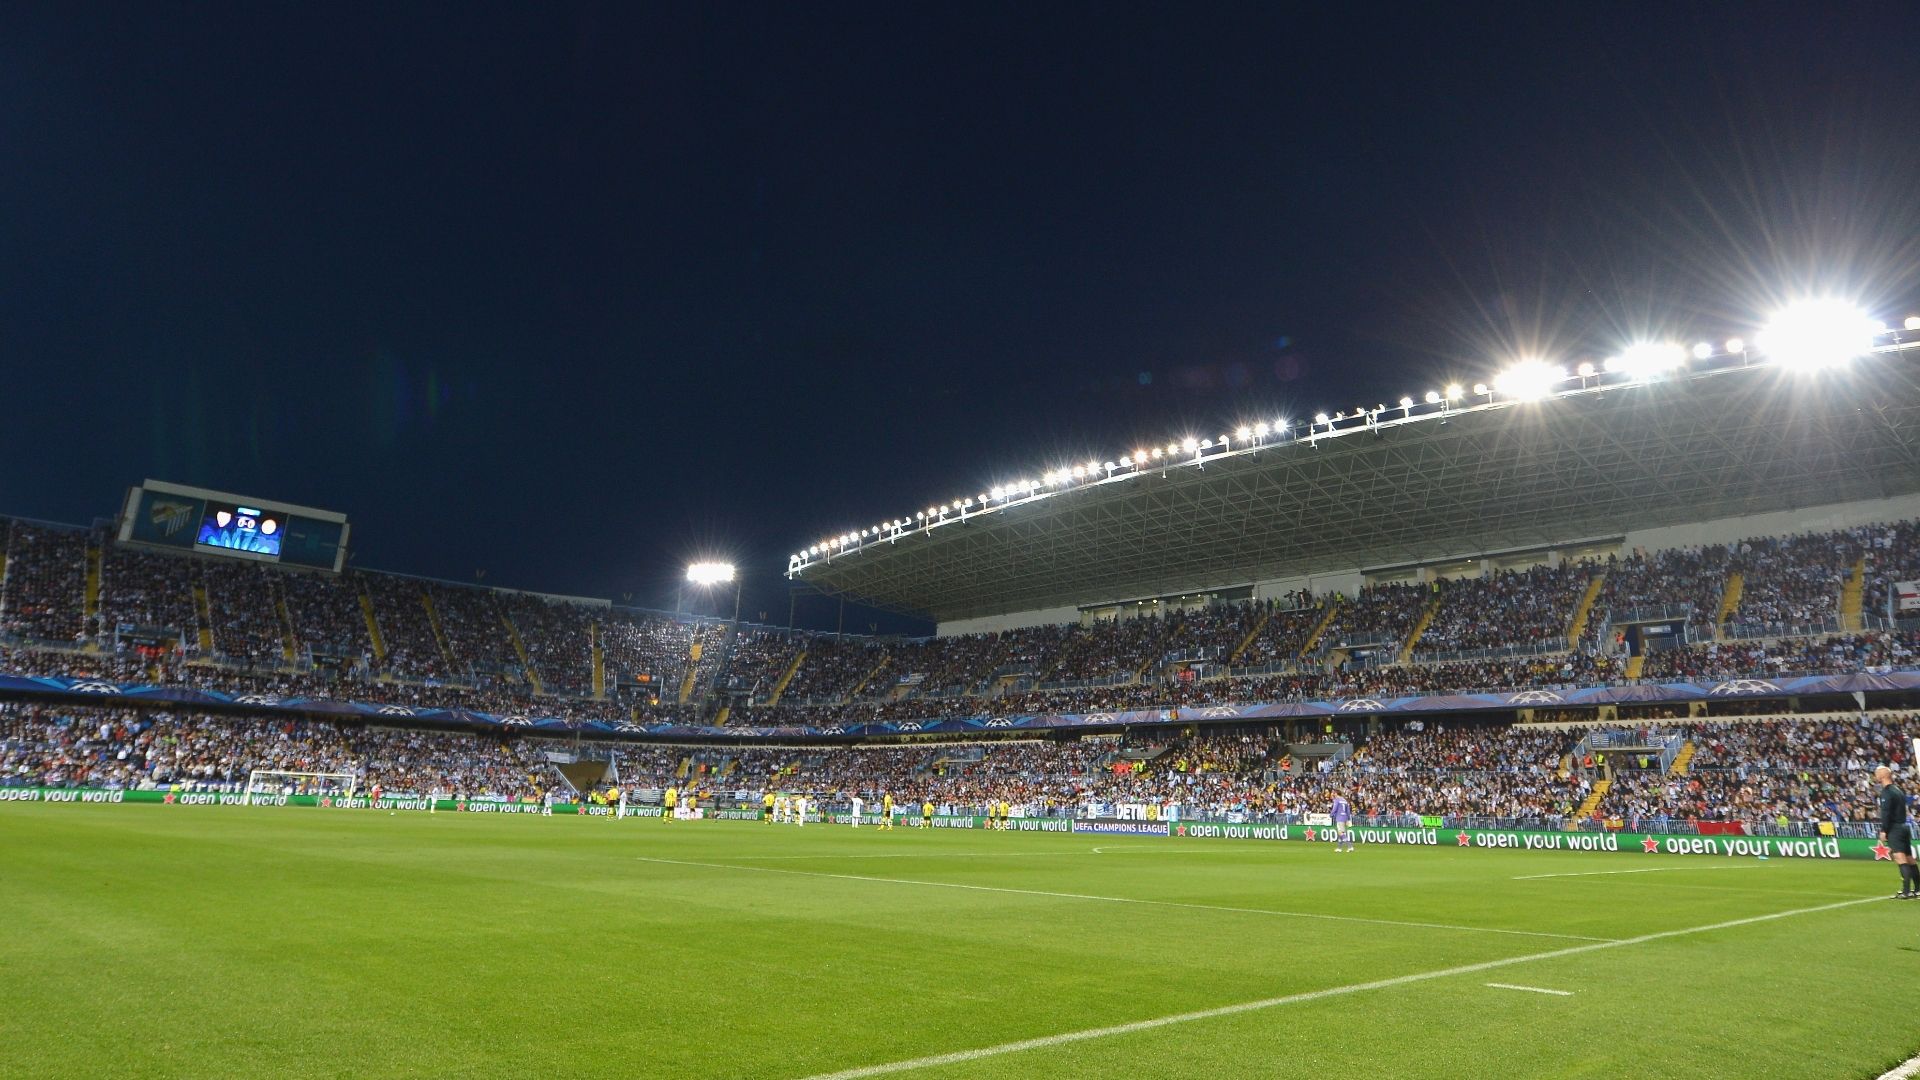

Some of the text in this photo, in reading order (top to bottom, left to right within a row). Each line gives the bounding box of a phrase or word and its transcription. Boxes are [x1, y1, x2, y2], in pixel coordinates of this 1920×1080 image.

[0, 788, 124, 803] open your world
[180, 793, 215, 805] open
[336, 798, 366, 808] open
[396, 798, 427, 810] world
[469, 802, 496, 812] open
[500, 804, 521, 814] your
[616, 808, 636, 818] yur
[637, 807, 662, 818] world
[742, 810, 758, 820] world
[932, 818, 949, 828] your
[950, 816, 973, 828] world
[994, 819, 1068, 832] oen your world
[1074, 822, 1168, 834] UEFA CHAMPIONS LEAGUE
[1190, 824, 1288, 840] open your world
[1321, 828, 1437, 845] opn your world
[1476, 833, 1618, 851] open your world
[1666, 837, 1840, 858] open your world
